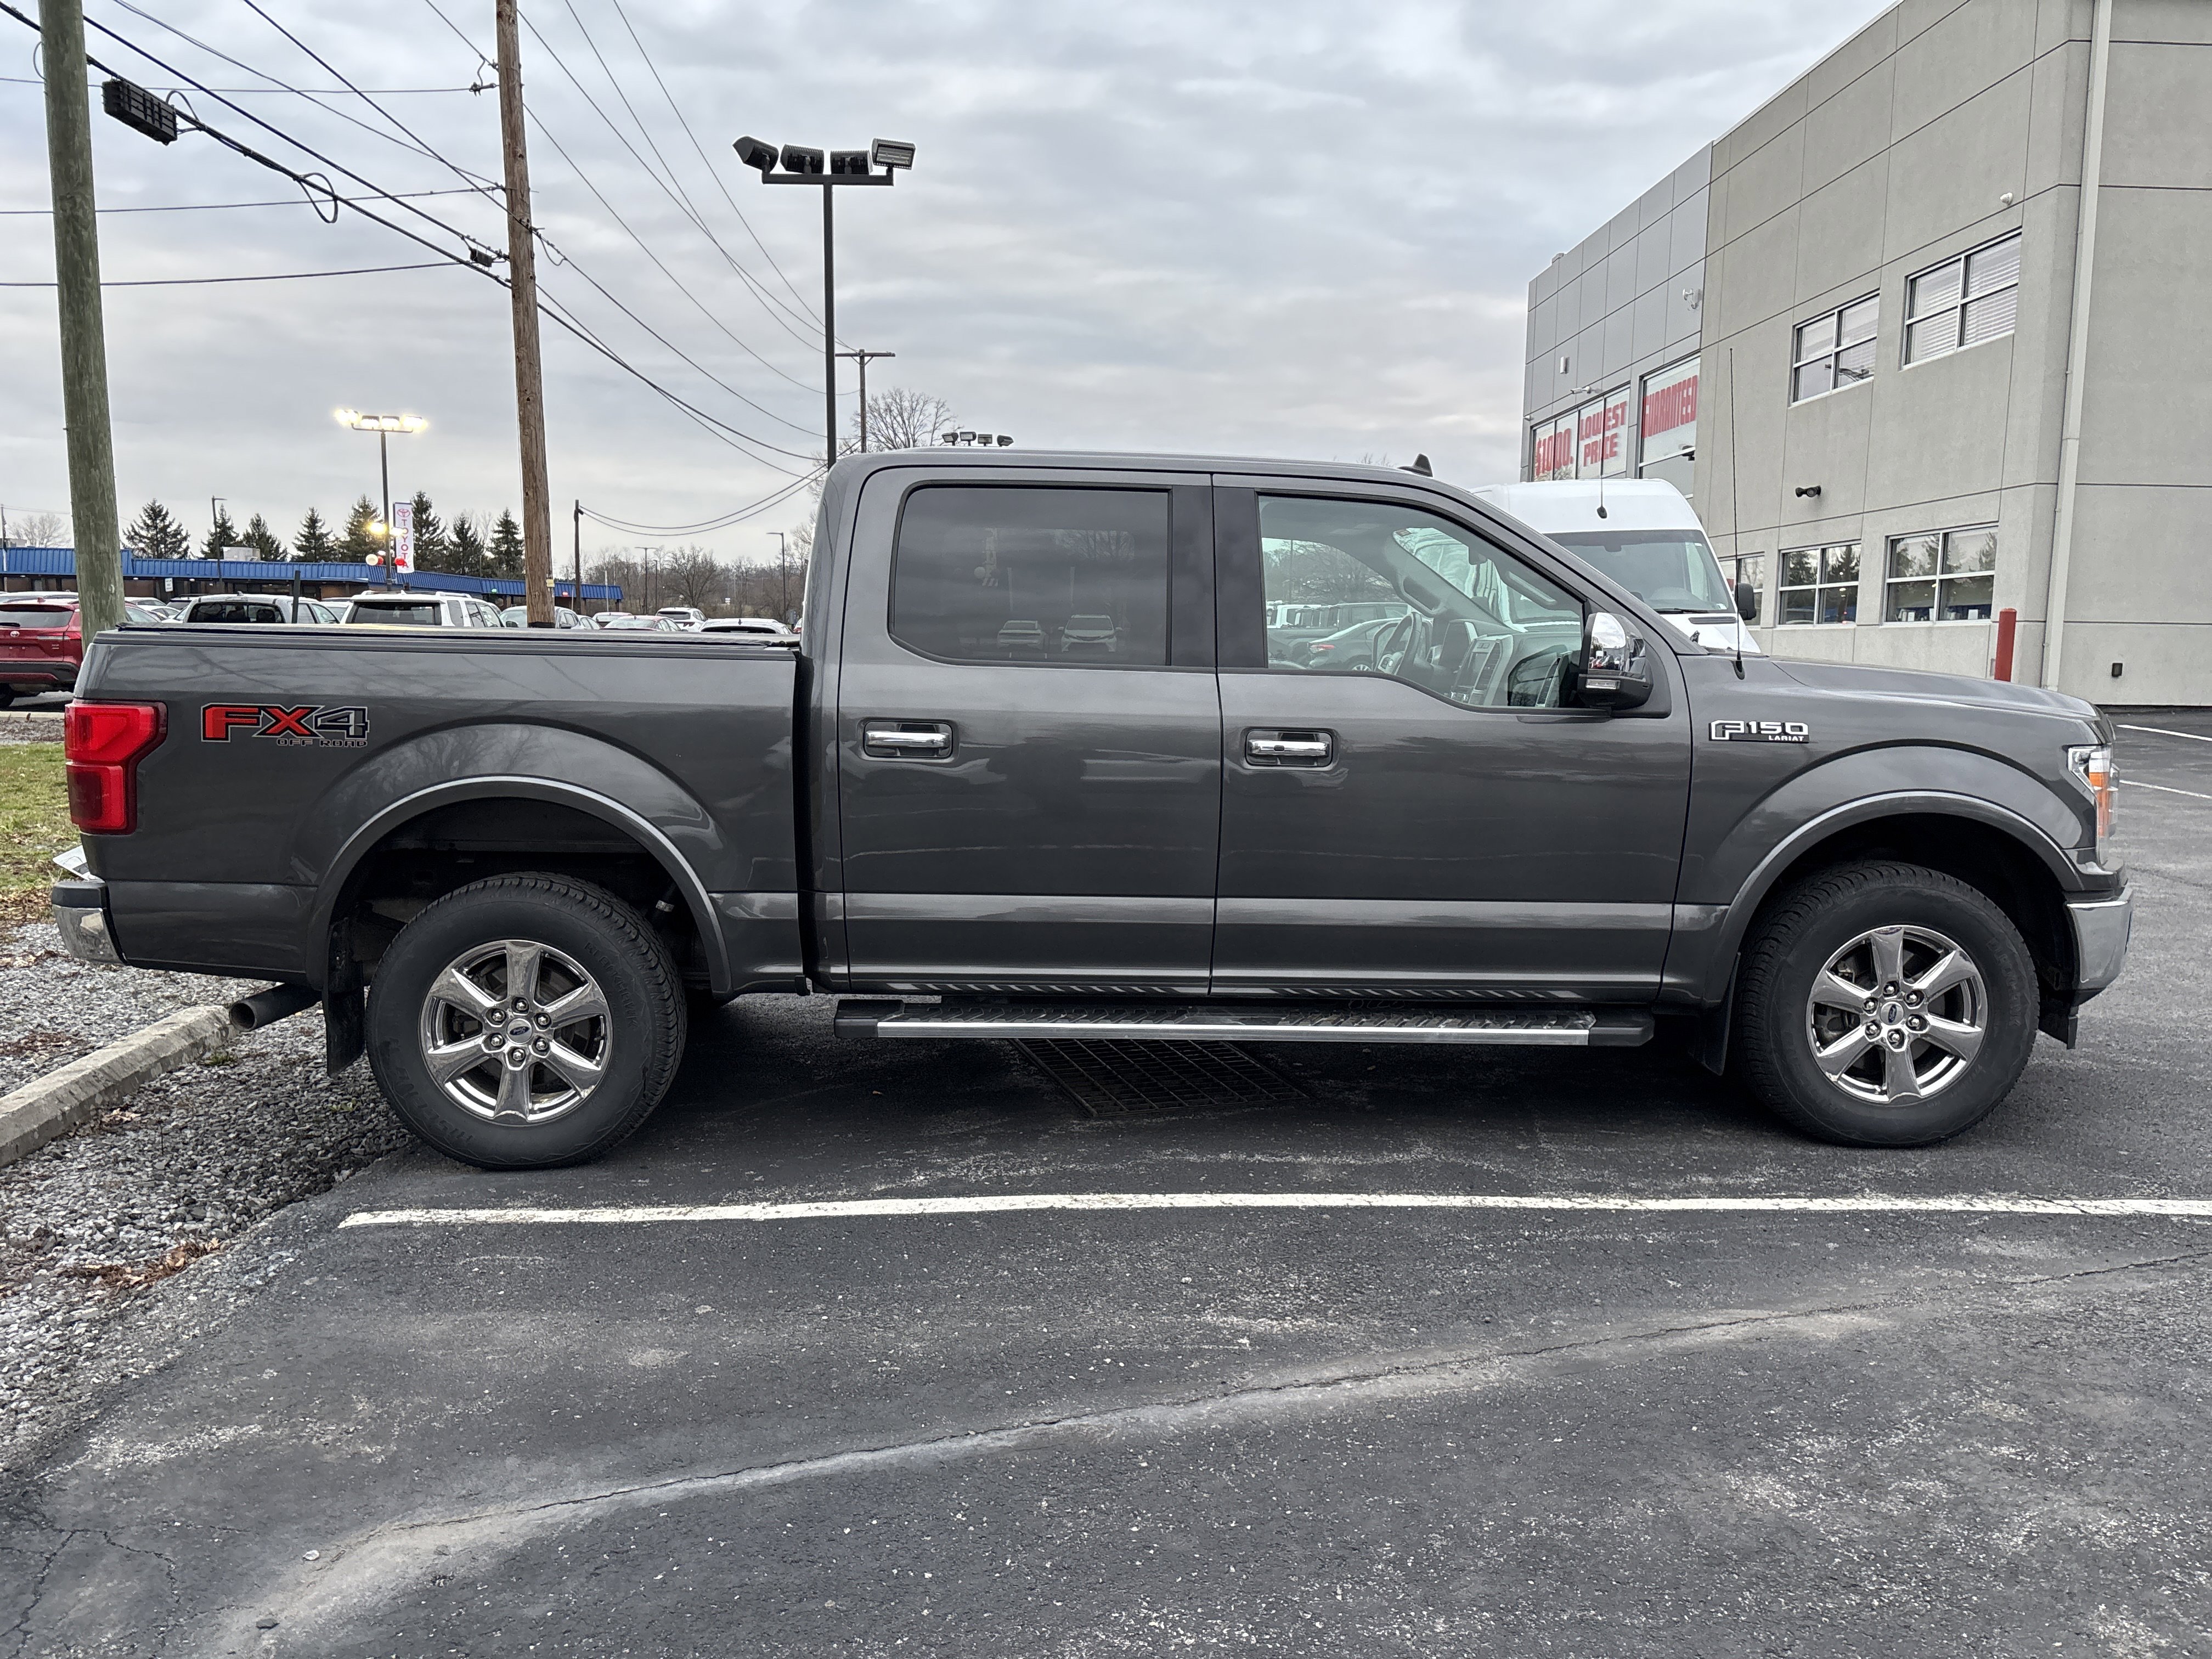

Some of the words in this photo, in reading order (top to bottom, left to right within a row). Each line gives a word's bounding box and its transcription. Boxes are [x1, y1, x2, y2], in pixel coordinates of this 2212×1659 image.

[1579, 400, 1628, 441] LOWEST
[1641, 375, 1698, 439] GUARANTEED
[1583, 432, 1618, 467] PRICE
[400, 518, 409, 568] TOYOTA
[201, 703, 370, 743] FX4
[276, 738, 313, 747] OFF
[319, 739, 368, 748] ROAD
